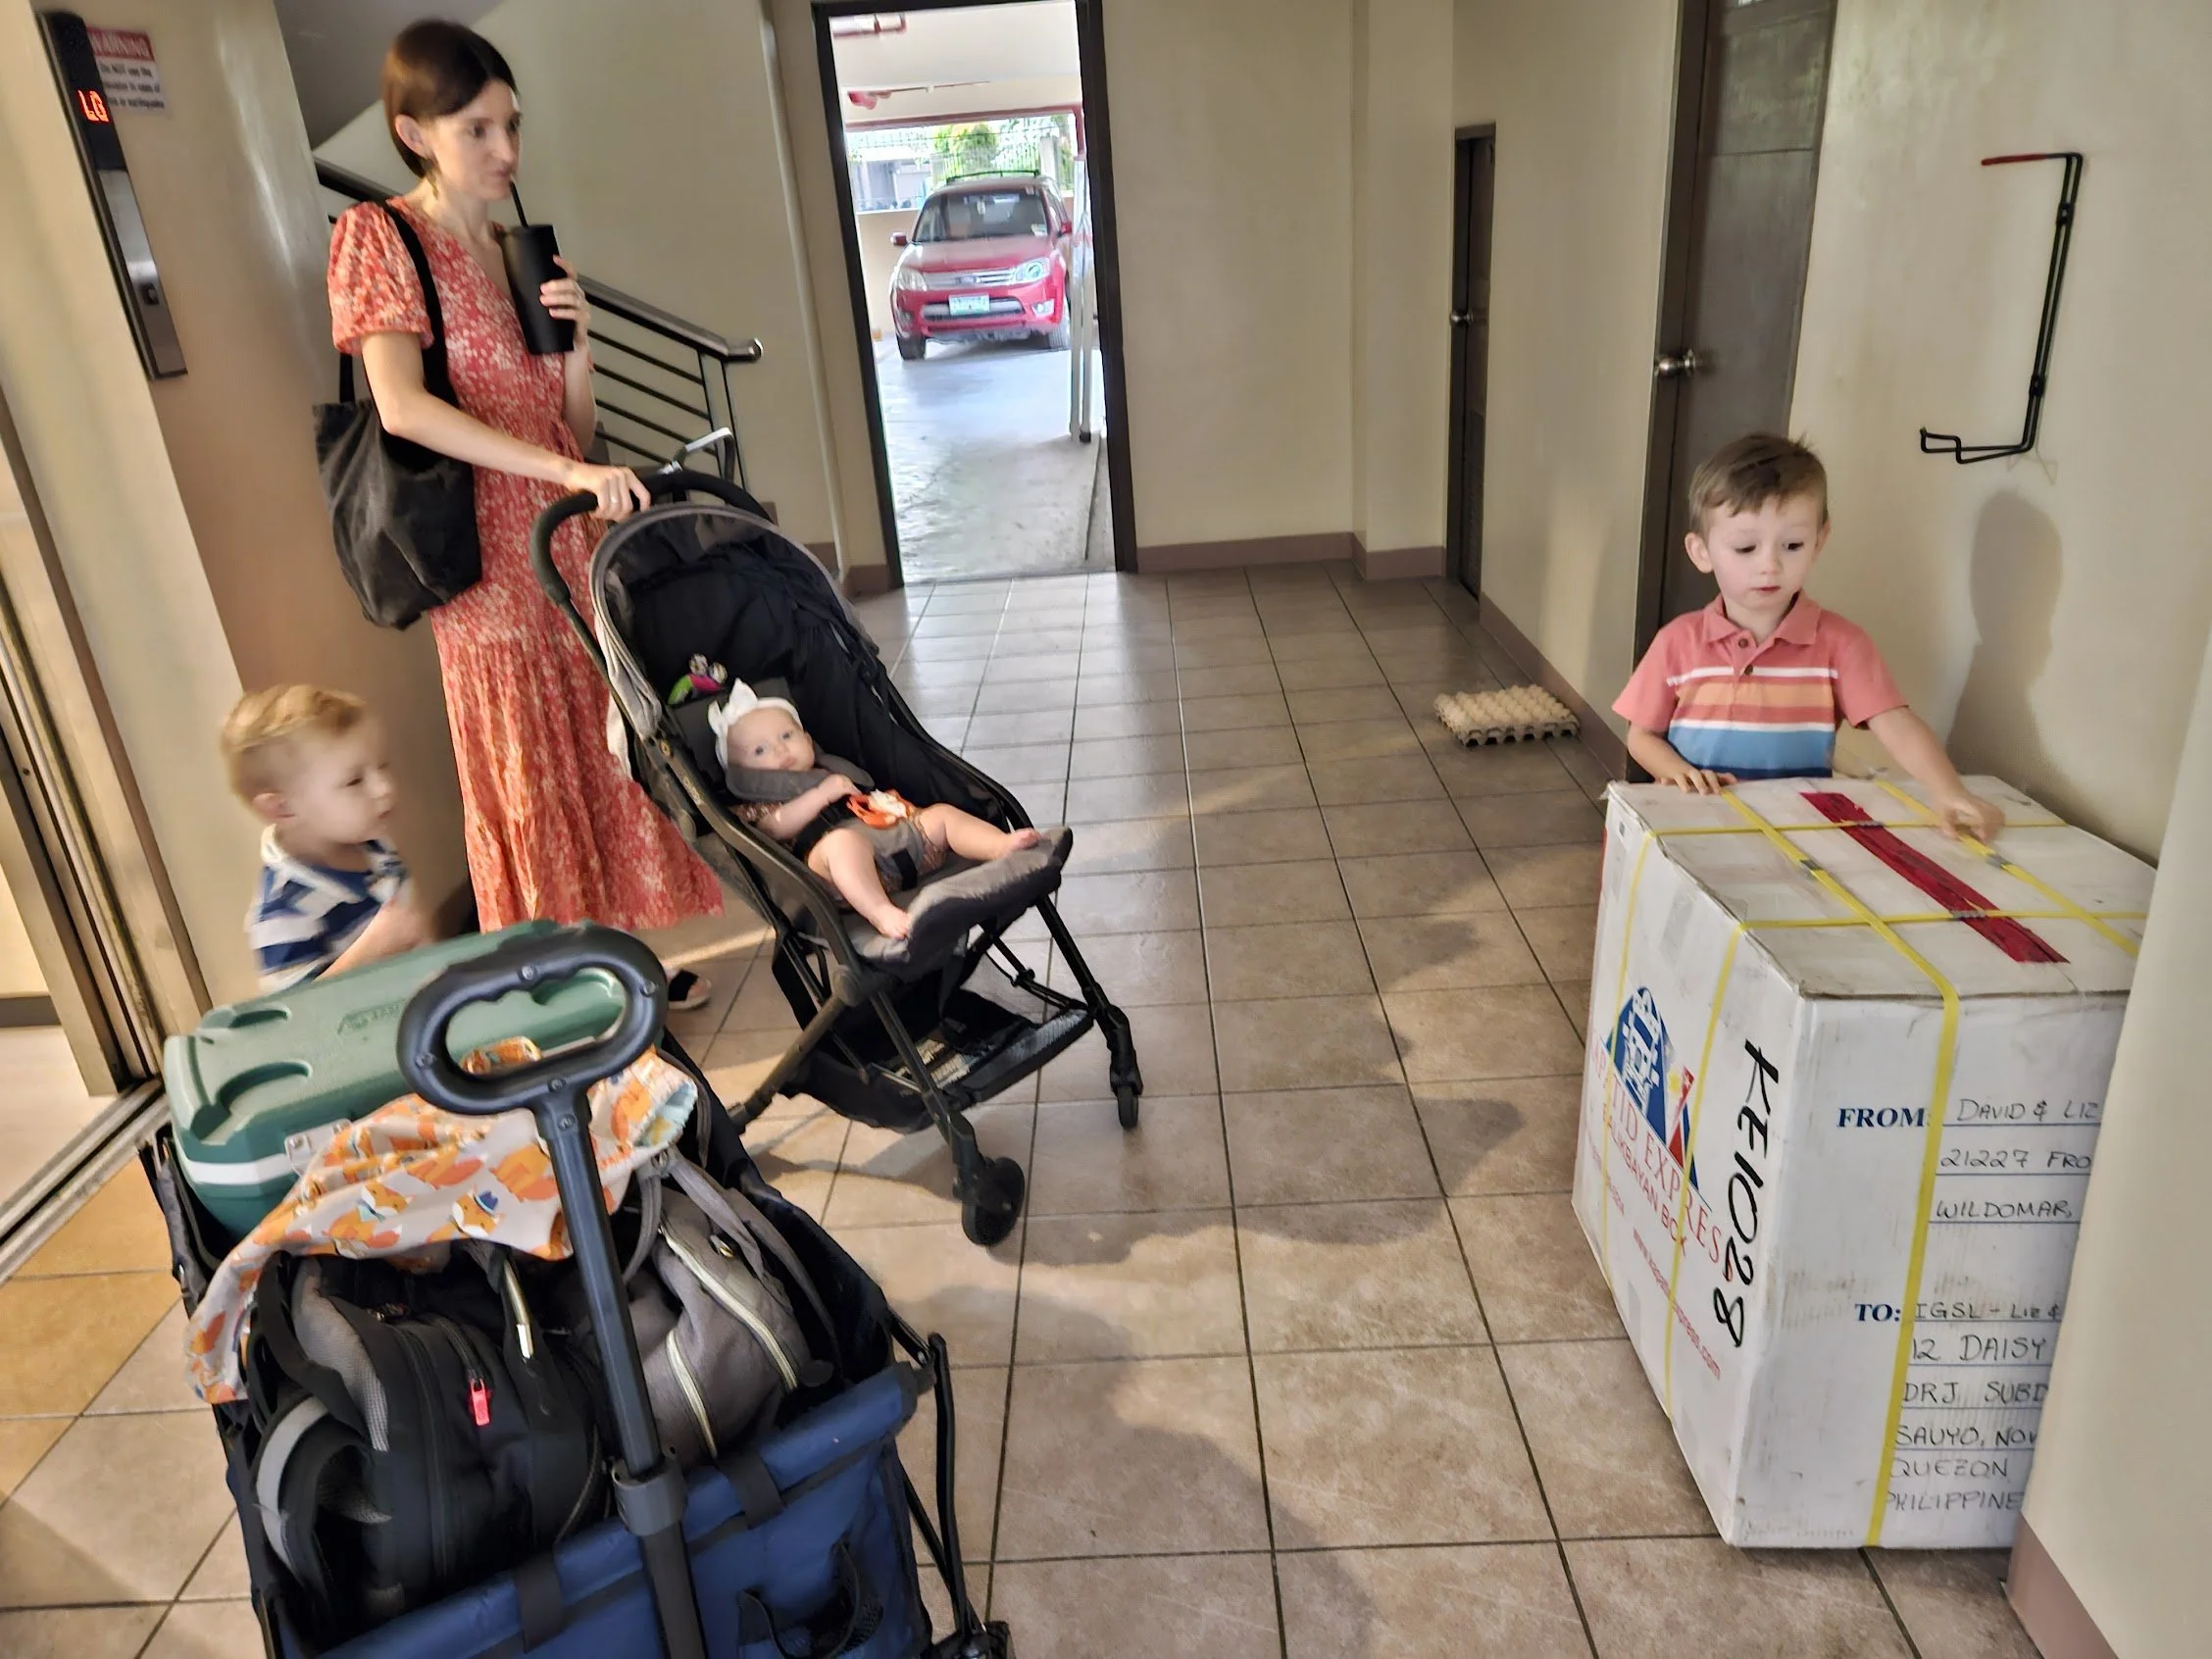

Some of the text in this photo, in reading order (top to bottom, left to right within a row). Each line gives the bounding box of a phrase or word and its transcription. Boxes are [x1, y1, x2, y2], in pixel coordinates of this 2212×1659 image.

[1956, 1098, 2026, 1122] DAVID
[1940, 1149, 2029, 1169] 21227
[1855, 1303, 1901, 1323] TO:
[1915, 1302, 1982, 1320] IGSL
[1912, 1334, 2047, 1362] 12 DAISY
[1902, 1382, 1959, 1404] DRJ
